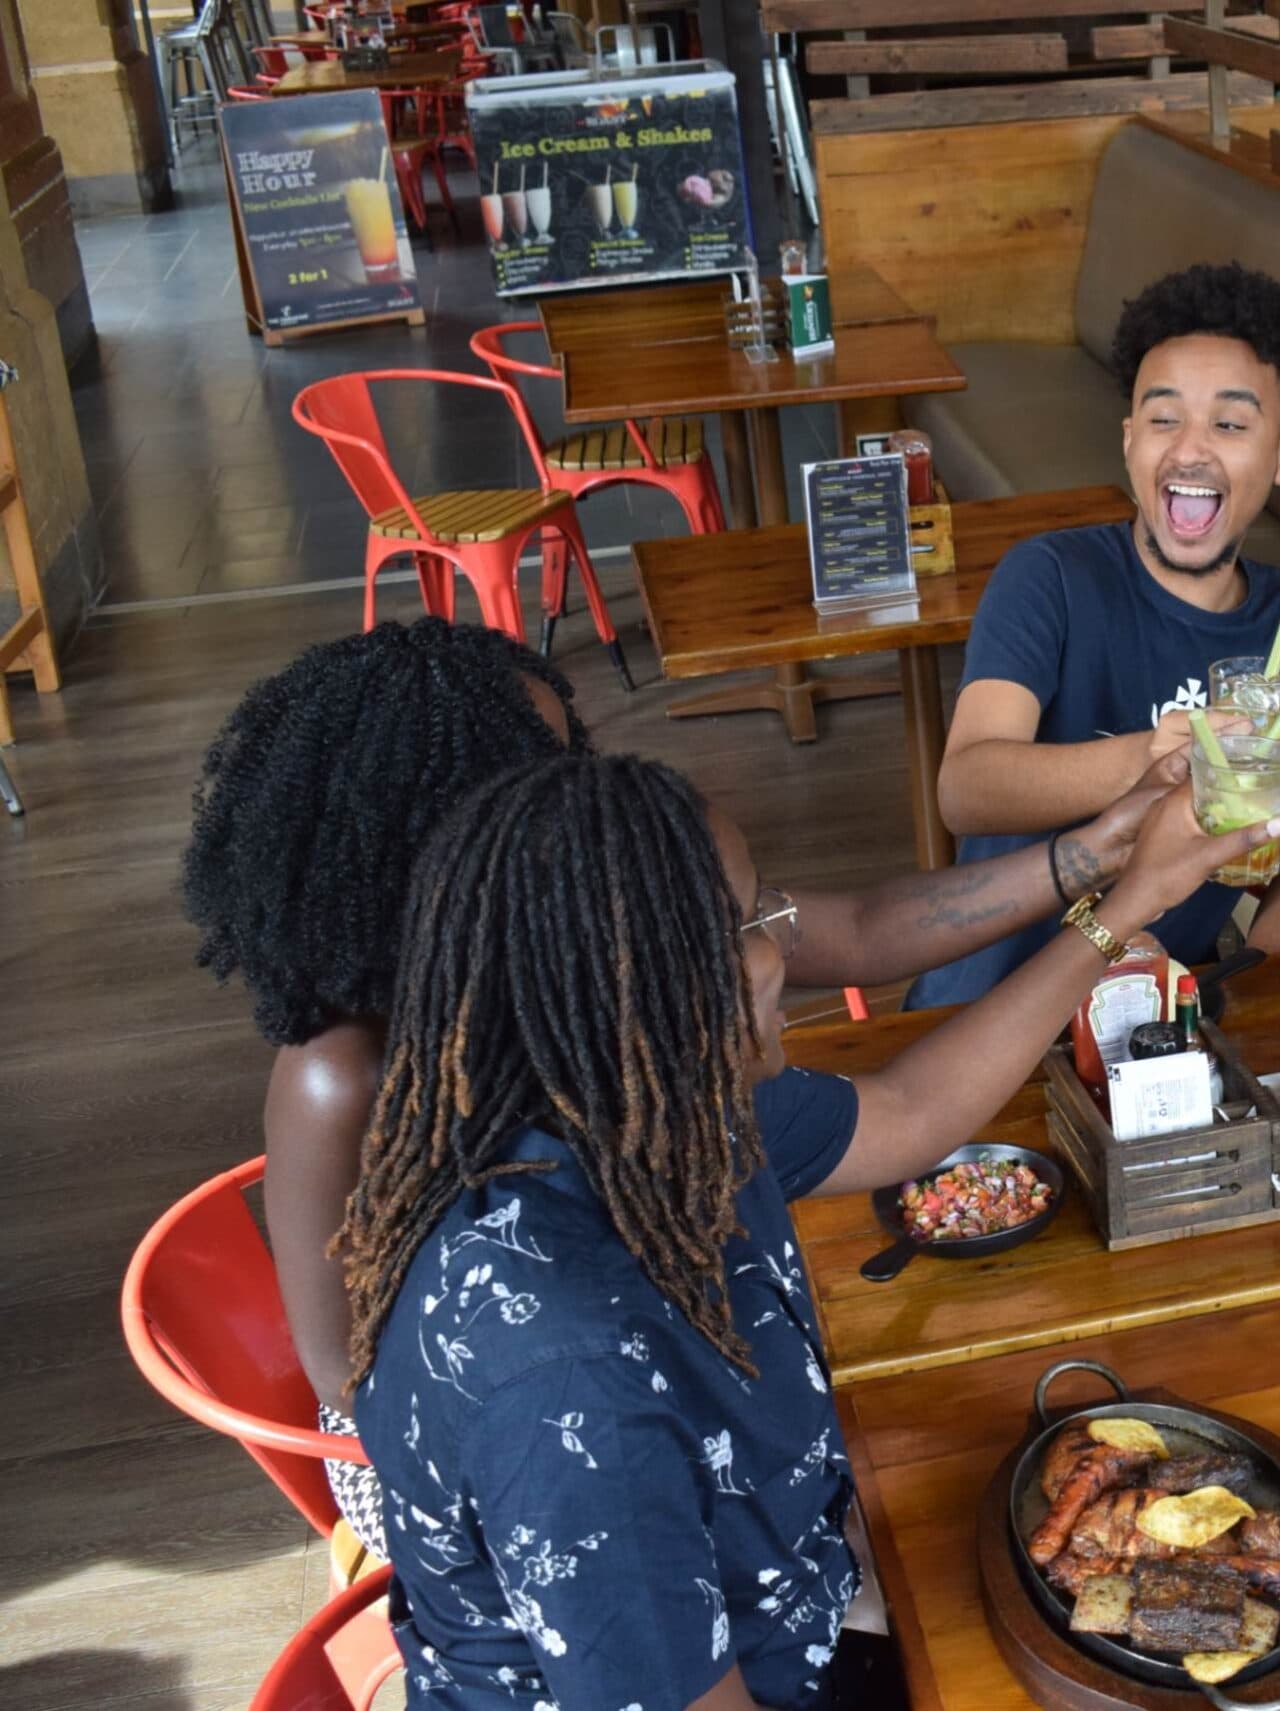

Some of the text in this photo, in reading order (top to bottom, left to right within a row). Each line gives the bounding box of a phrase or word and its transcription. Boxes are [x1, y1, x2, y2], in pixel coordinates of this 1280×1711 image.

[500, 125, 712, 158] Ice Cream & Shakes
[238, 149, 315, 173] Happy
[242, 171, 317, 195] Hour
[288, 269, 328, 286] 2 for 1
